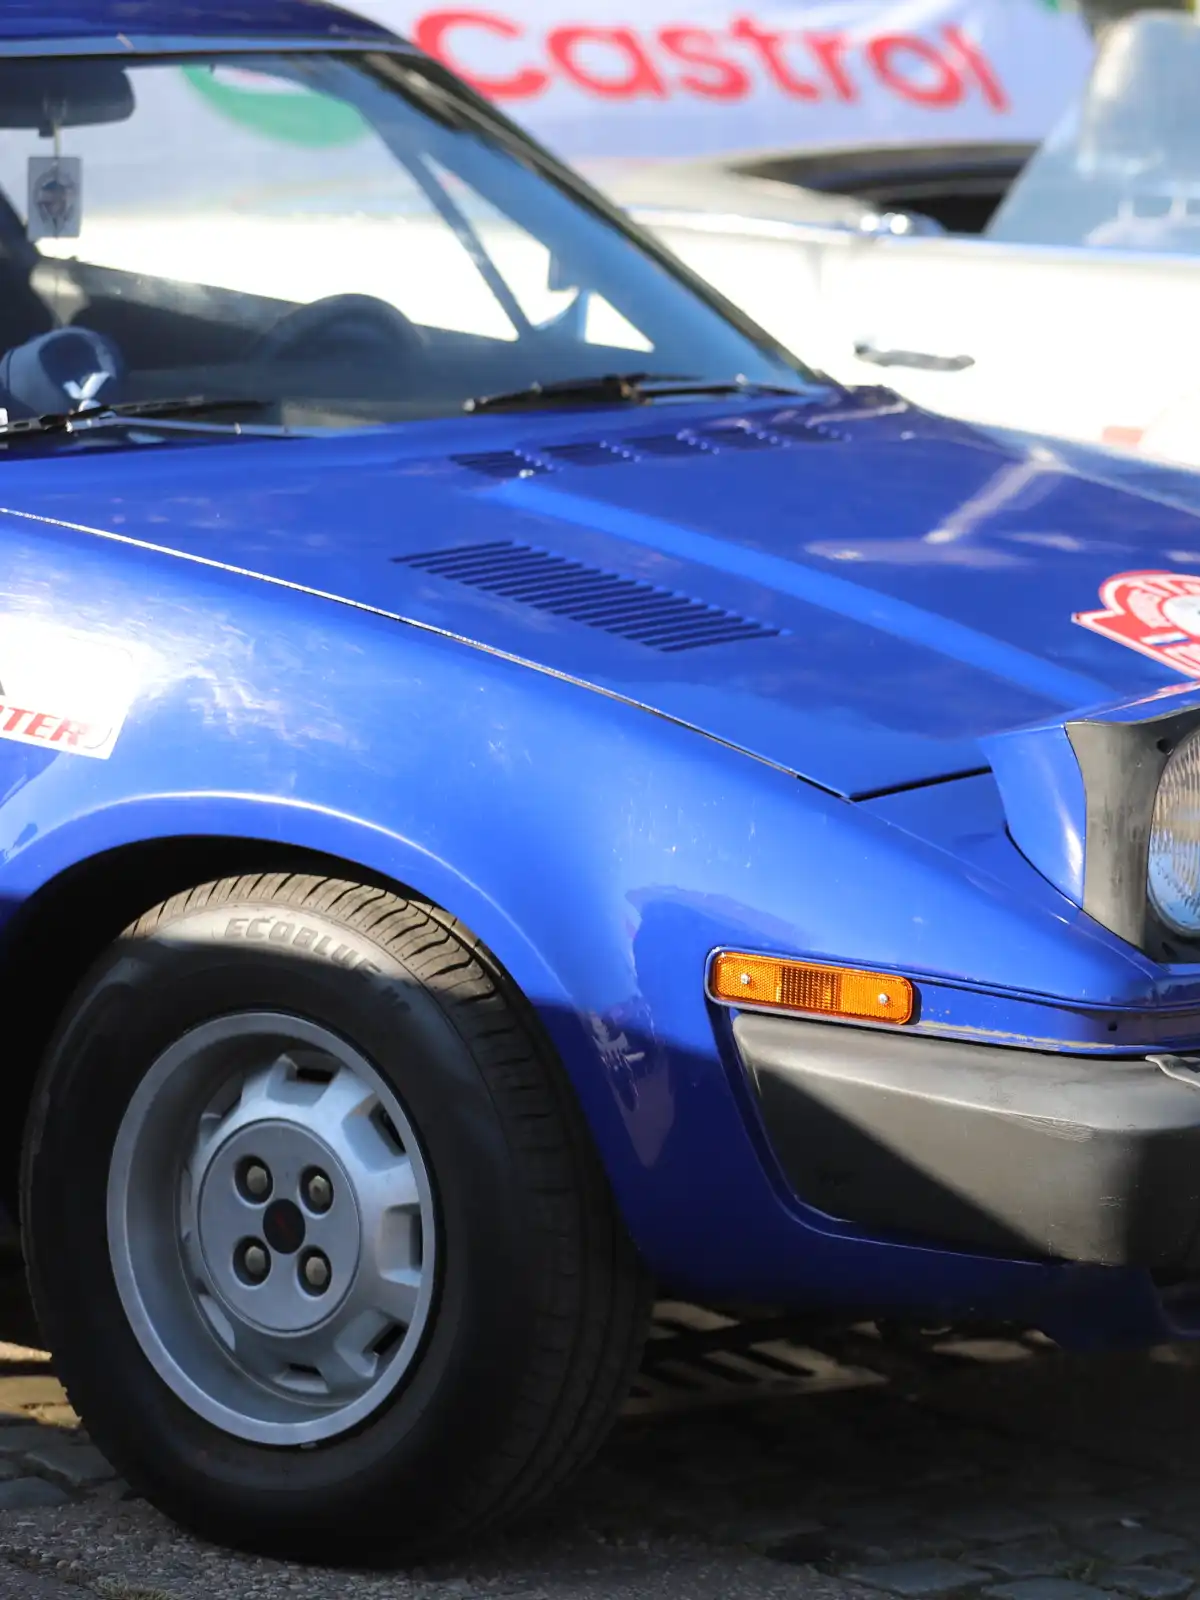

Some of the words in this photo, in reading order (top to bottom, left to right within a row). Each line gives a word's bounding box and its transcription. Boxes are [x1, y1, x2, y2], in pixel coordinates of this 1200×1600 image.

[414, 11, 1006, 112] Castrol
[0, 704, 89, 745] TER
[225, 916, 382, 983] ECOBLUE
